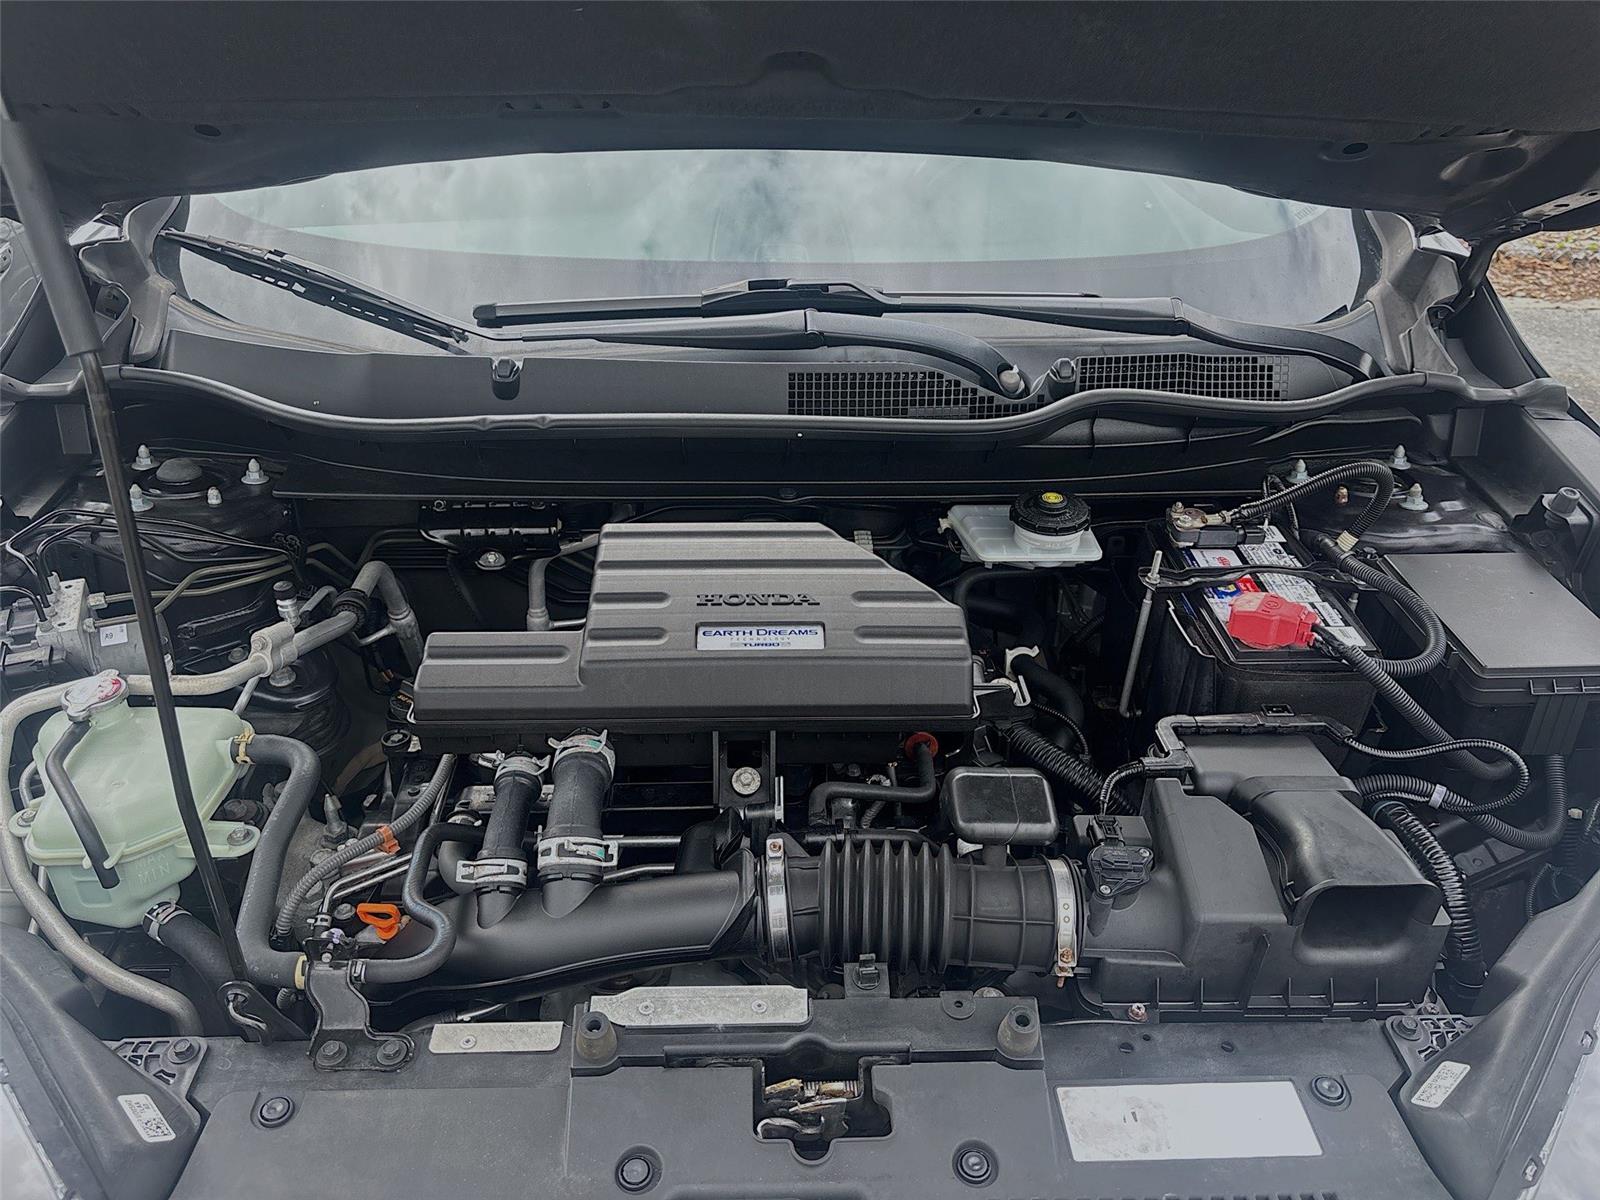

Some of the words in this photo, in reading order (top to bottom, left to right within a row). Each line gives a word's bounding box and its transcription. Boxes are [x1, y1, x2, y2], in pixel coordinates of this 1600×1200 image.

[696, 593, 820, 607] HONDA
[702, 629, 753, 637] EARTH
[756, 628, 818, 637] DREAMS
